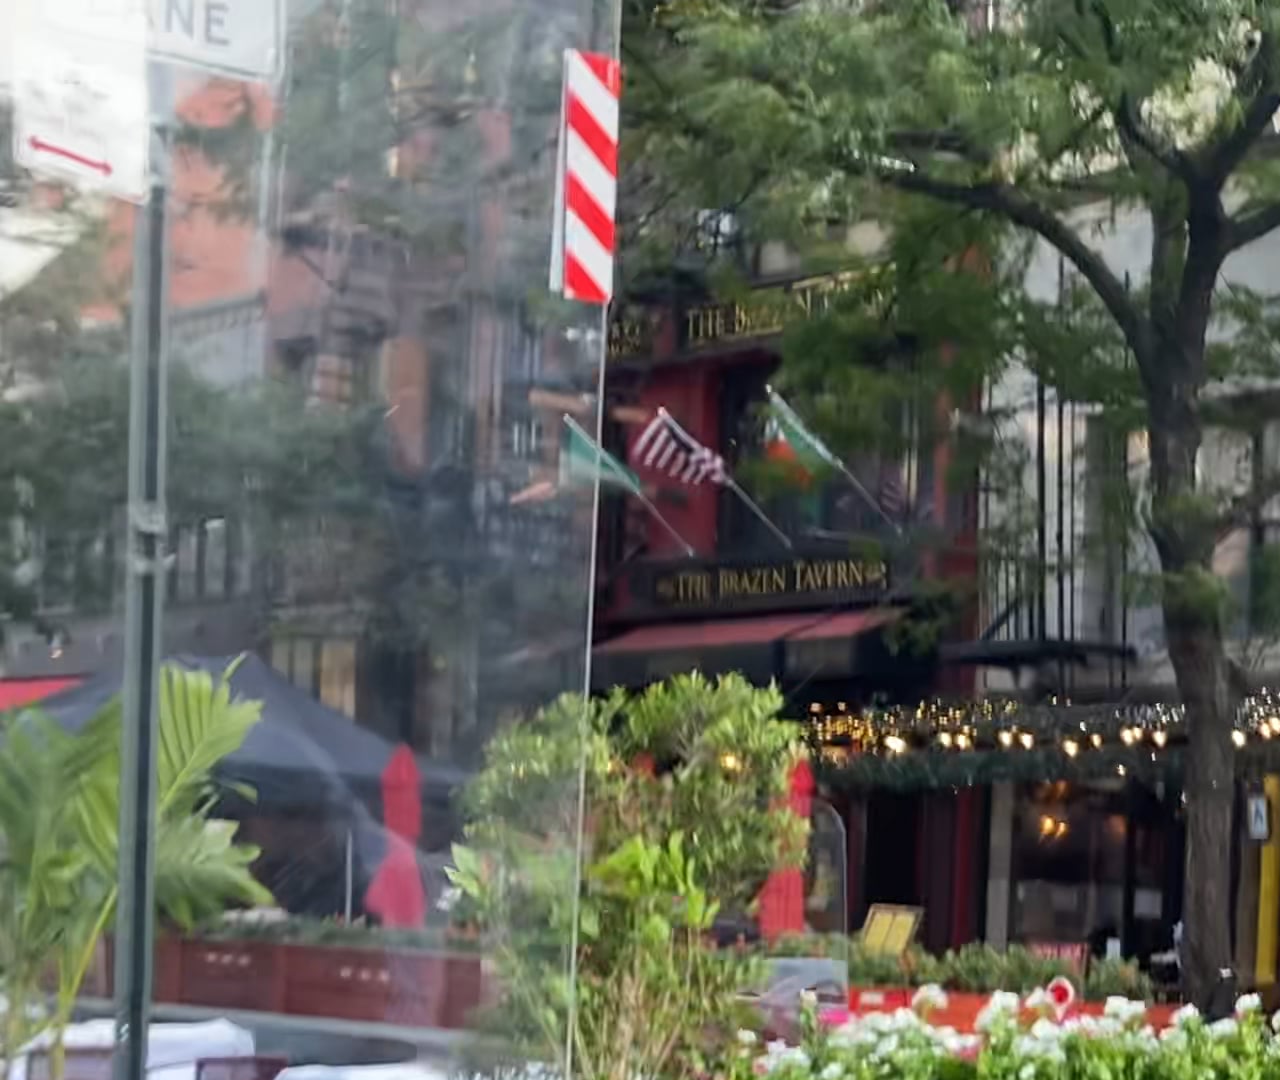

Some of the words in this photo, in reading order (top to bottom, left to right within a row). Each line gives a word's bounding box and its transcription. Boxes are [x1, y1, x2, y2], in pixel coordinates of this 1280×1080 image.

[677, 571, 711, 601] THE
[719, 564, 787, 595] BRAZEN
[794, 558, 863, 592] TAVERN
